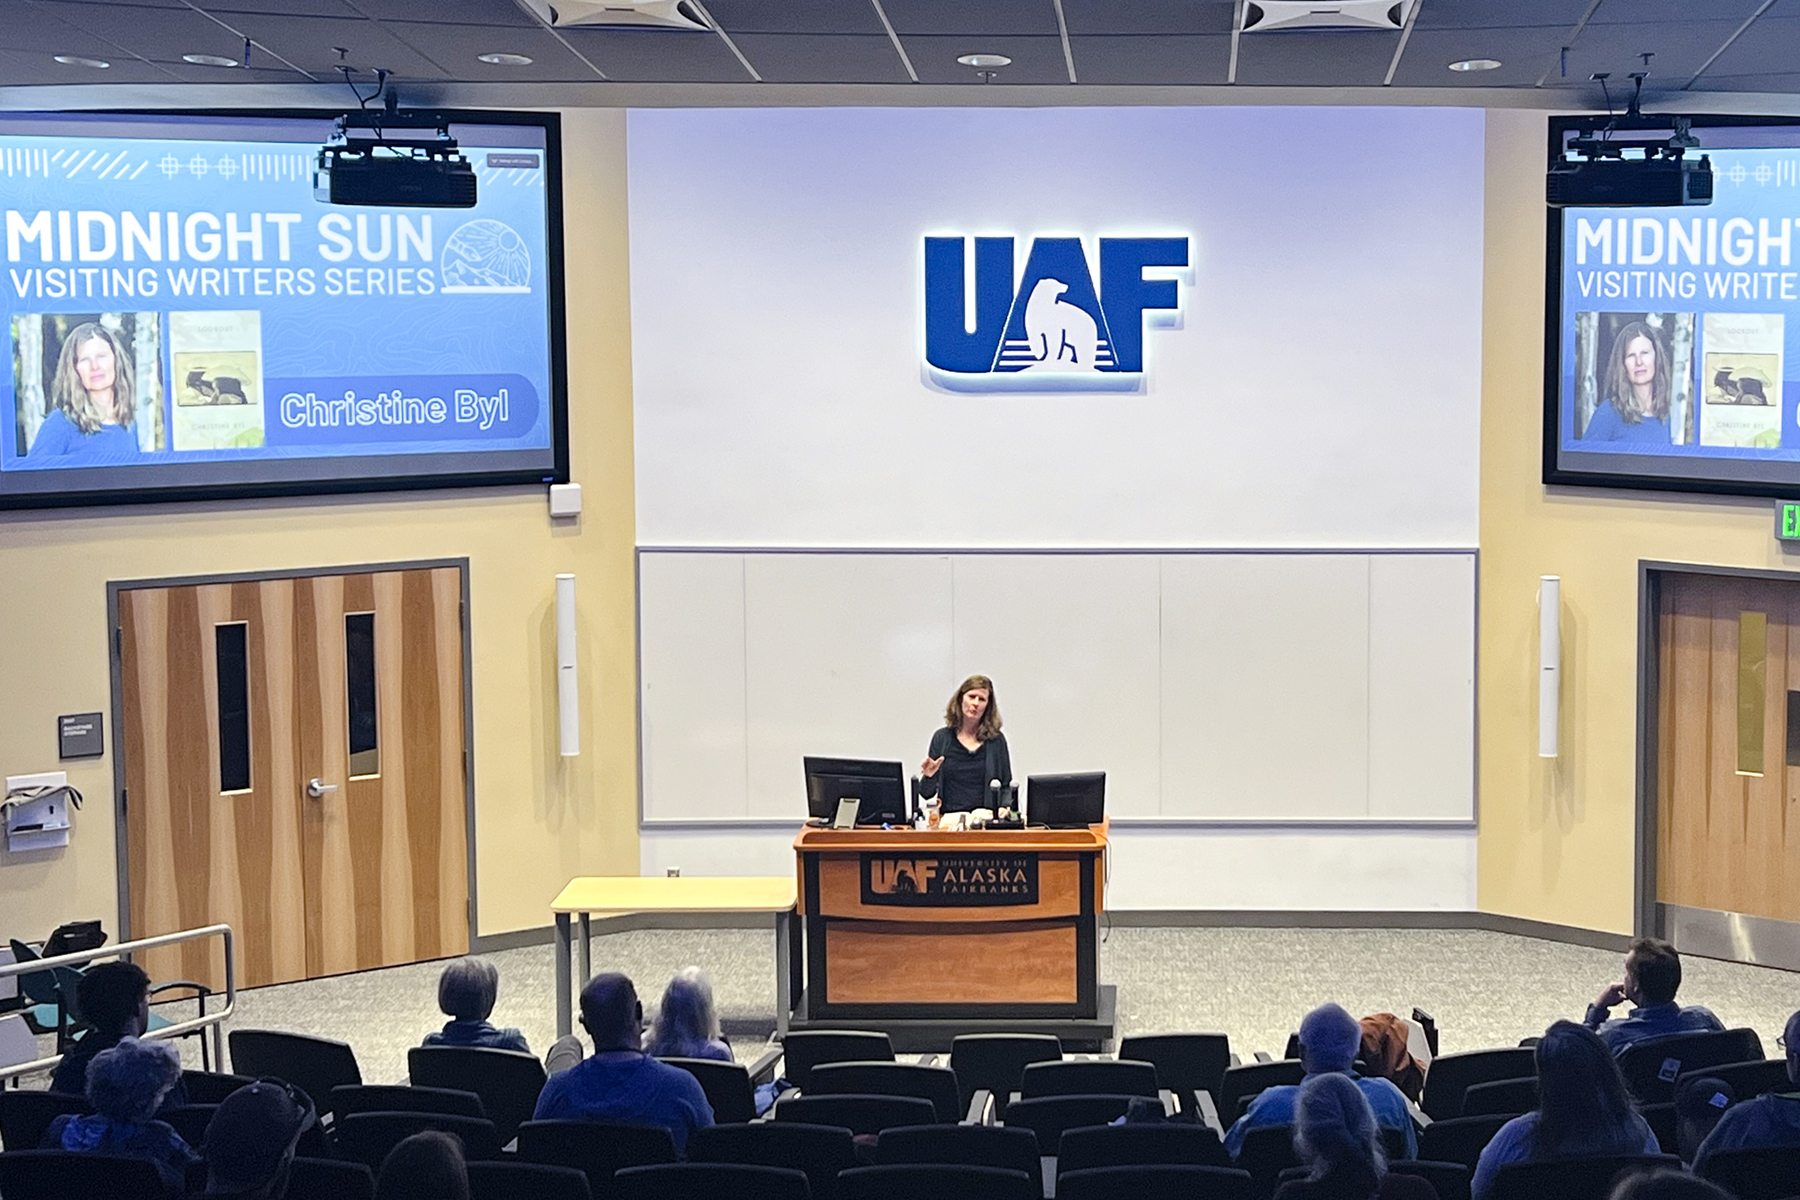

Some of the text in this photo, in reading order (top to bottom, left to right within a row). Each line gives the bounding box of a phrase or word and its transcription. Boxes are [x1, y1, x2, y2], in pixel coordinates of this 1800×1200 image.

[6, 210, 433, 262] MIDNIGHT SUN
[1576, 217, 1800, 266] MIDNIGH
[9, 267, 435, 298] VISITING WRITERS SERIES
[1577, 271, 1696, 298] VISITING
[924, 236, 1189, 373] UAF
[280, 388, 509, 430] Christine Byl
[871, 859, 939, 894] UAF
[943, 868, 1028, 883] ALASKA
[1014, 859, 1028, 867] OF
[942, 885, 1029, 894] FAIRBANKS
